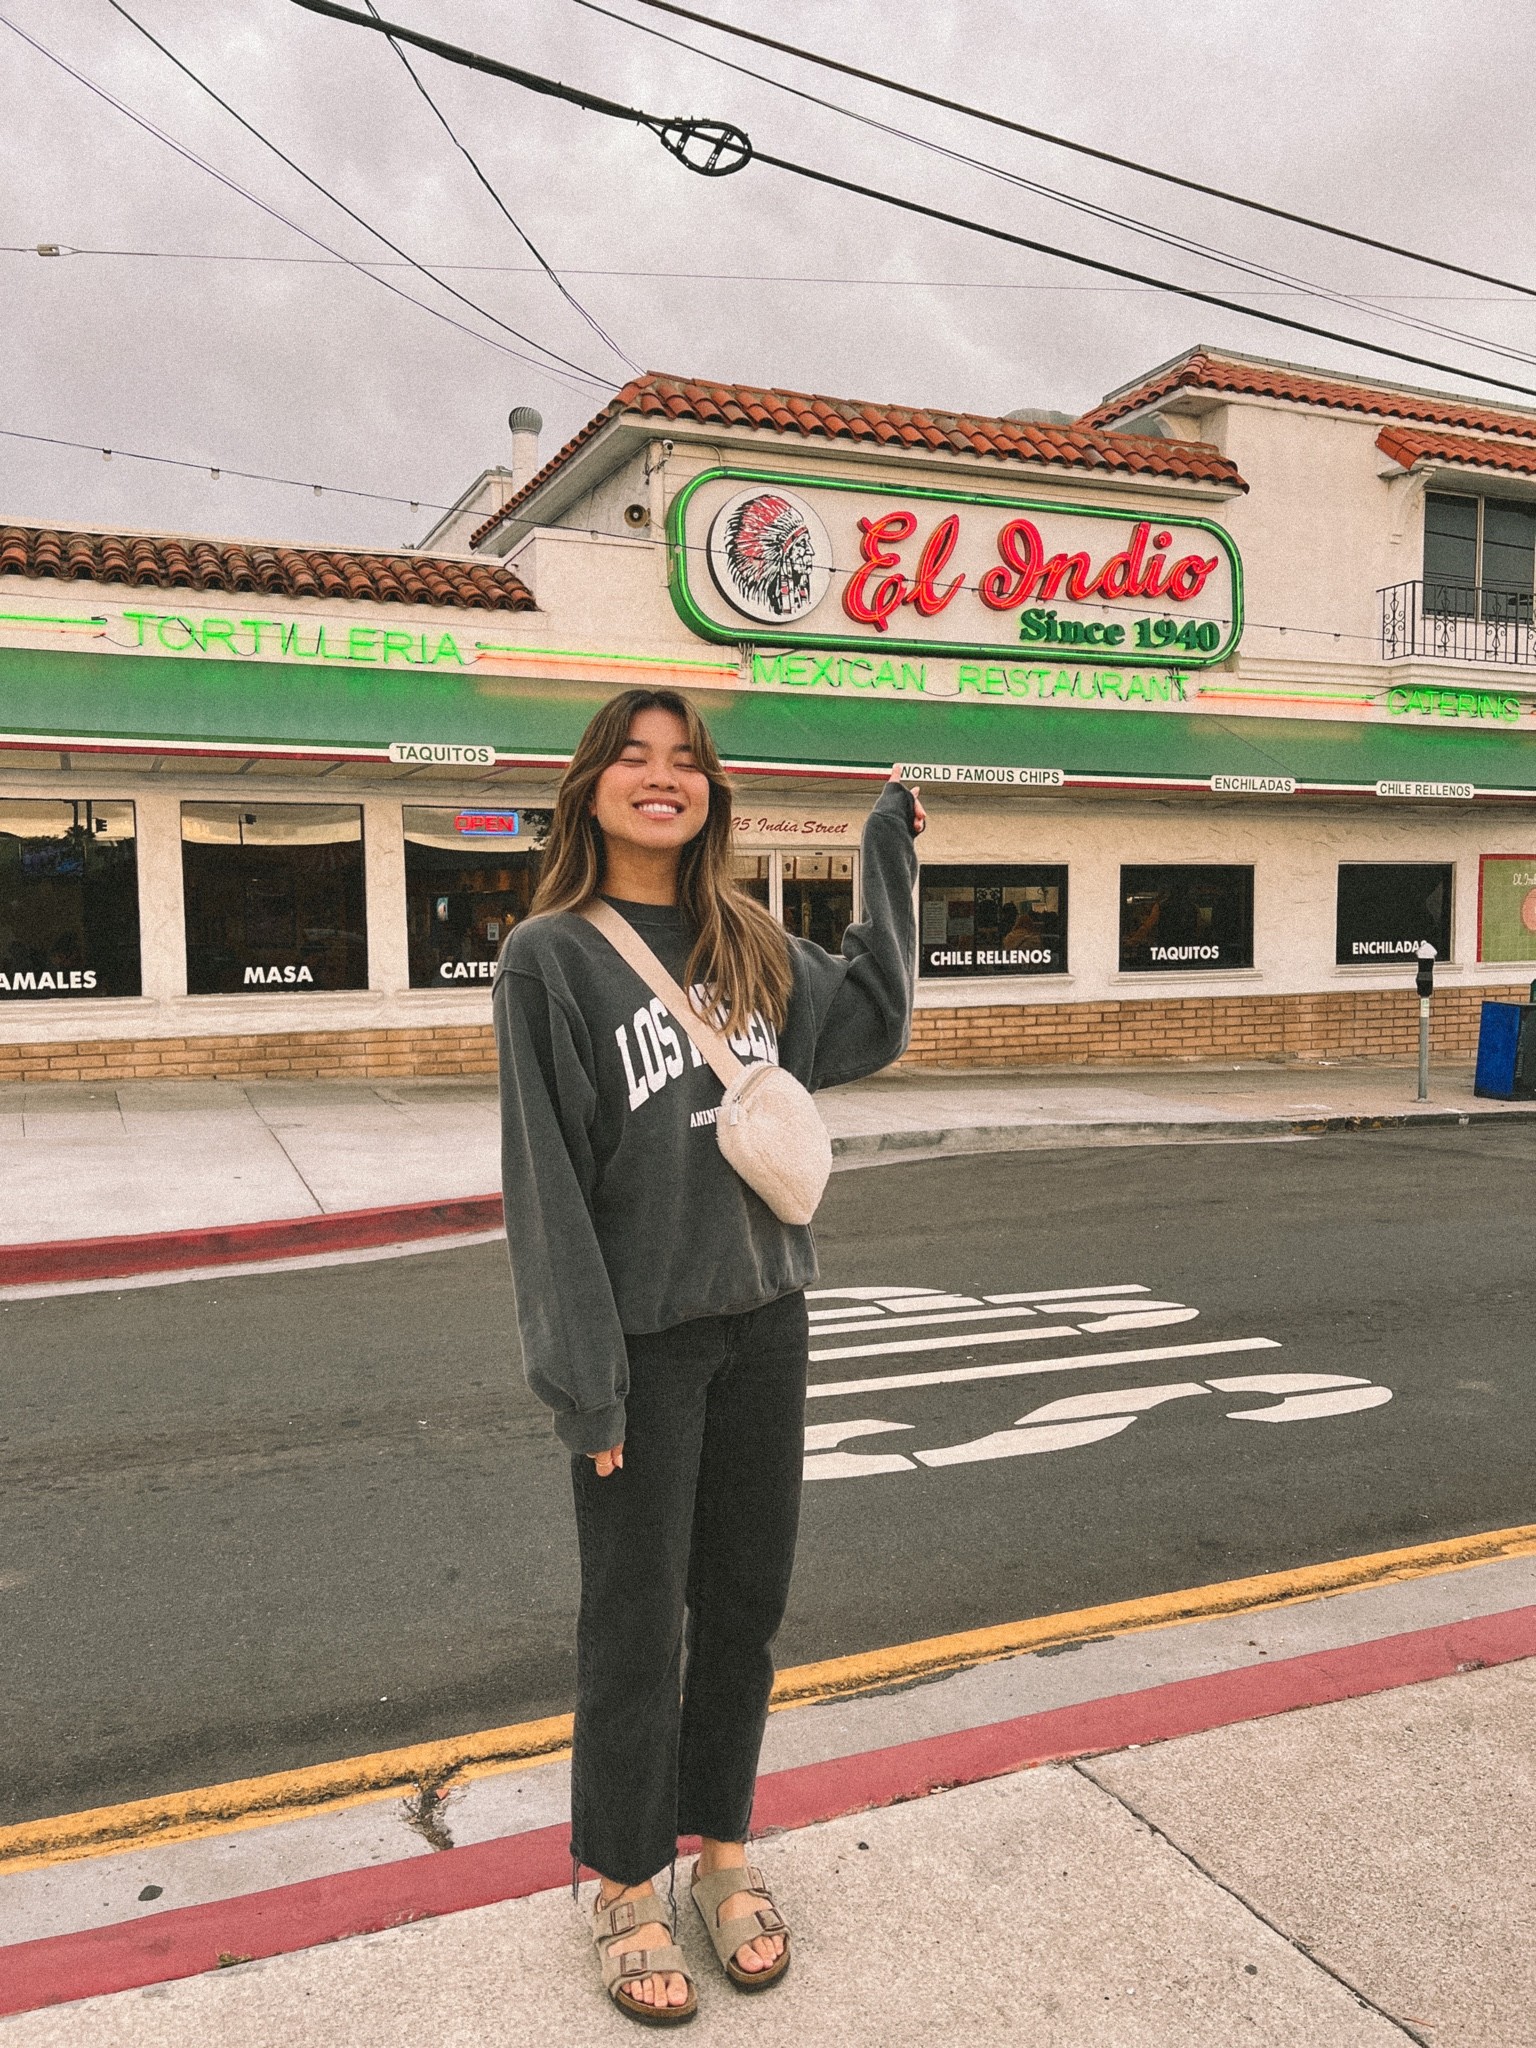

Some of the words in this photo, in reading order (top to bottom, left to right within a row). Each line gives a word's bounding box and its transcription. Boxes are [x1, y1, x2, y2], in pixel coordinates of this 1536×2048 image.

[842, 511, 965, 632] El
[979, 518, 1218, 611] Indio
[123, 612, 464, 666] TORTILLERIA
[1019, 609, 1125, 646] Since
[1134, 617, 1220, 652] 1940
[753, 654, 924, 691] MEXICAN
[960, 664, 1190, 701] RESTAURANT
[1388, 689, 1520, 721] CATERING
[396, 746, 489, 763] TAQUITOS
[901, 766, 951, 780] WORLD
[957, 769, 1014, 782] FAMOUS
[1019, 771, 1060, 784] CHIPS
[1215, 778, 1292, 792] ENCHILADAS
[1380, 783, 1413, 796] CHILE
[1415, 784, 1471, 797] RELLENOS
[454, 815, 514, 832] OPEN
[757, 818, 799, 833] India
[801, 821, 849, 834] Street
[1150, 945, 1219, 960] TAQUITOS
[1352, 940, 1427, 955] ENCHILADA
[930, 951, 973, 966] CHILE
[976, 949, 1051, 965] RELLENOS
[244, 966, 313, 984] MASA
[615, 997, 684, 1112] LOS
